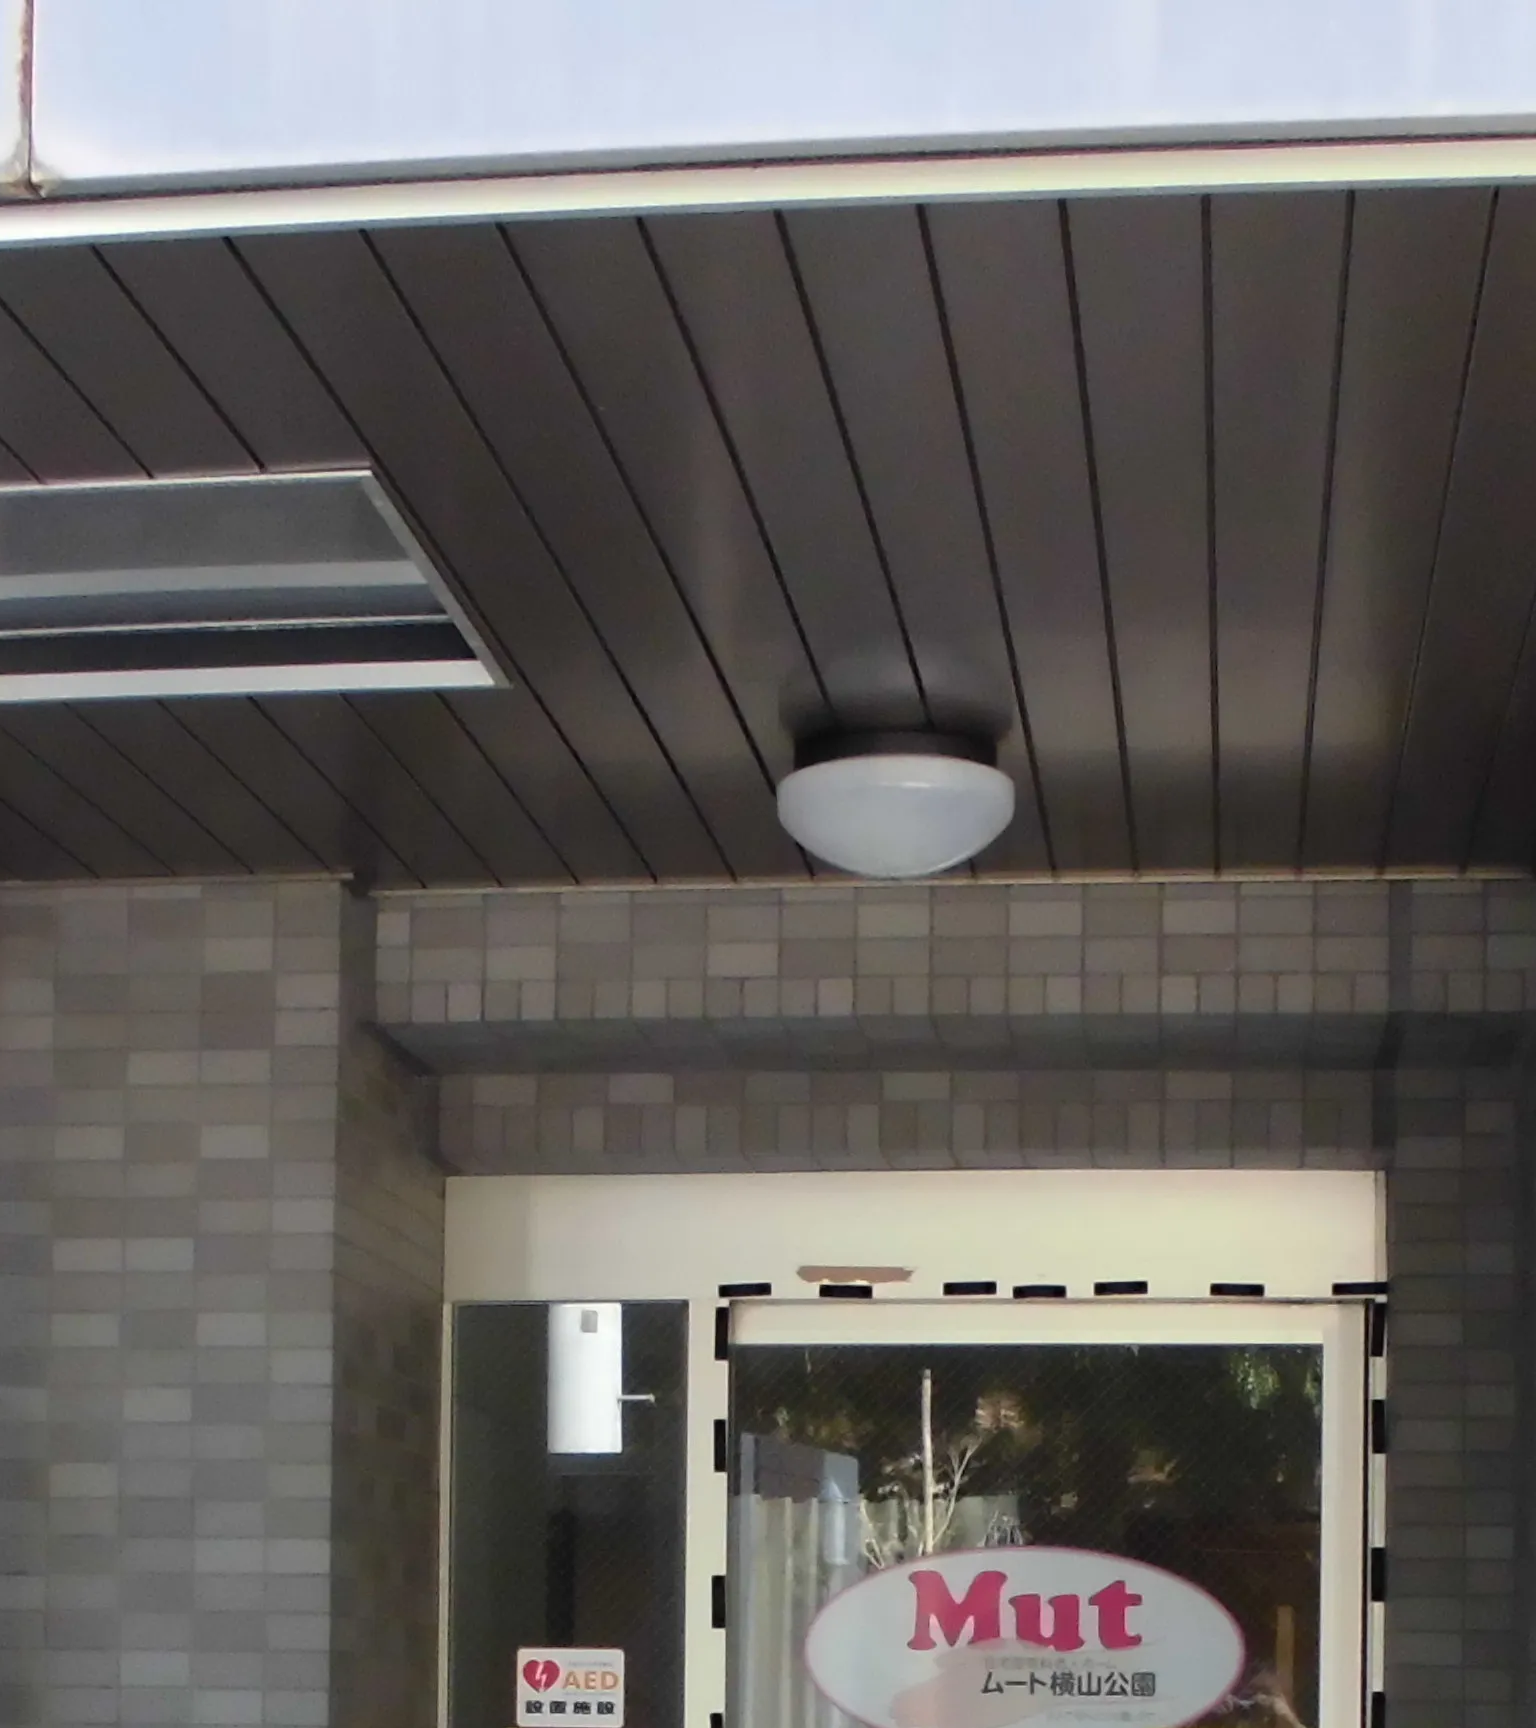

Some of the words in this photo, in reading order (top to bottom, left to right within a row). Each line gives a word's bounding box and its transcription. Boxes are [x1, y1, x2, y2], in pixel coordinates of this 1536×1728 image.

[907, 1570, 1143, 1652] Mut
[562, 1671, 620, 1690] AED
[981, 1671, 1156, 1697] ムート横山公園
[525, 1700, 614, 1715] 設置施設
